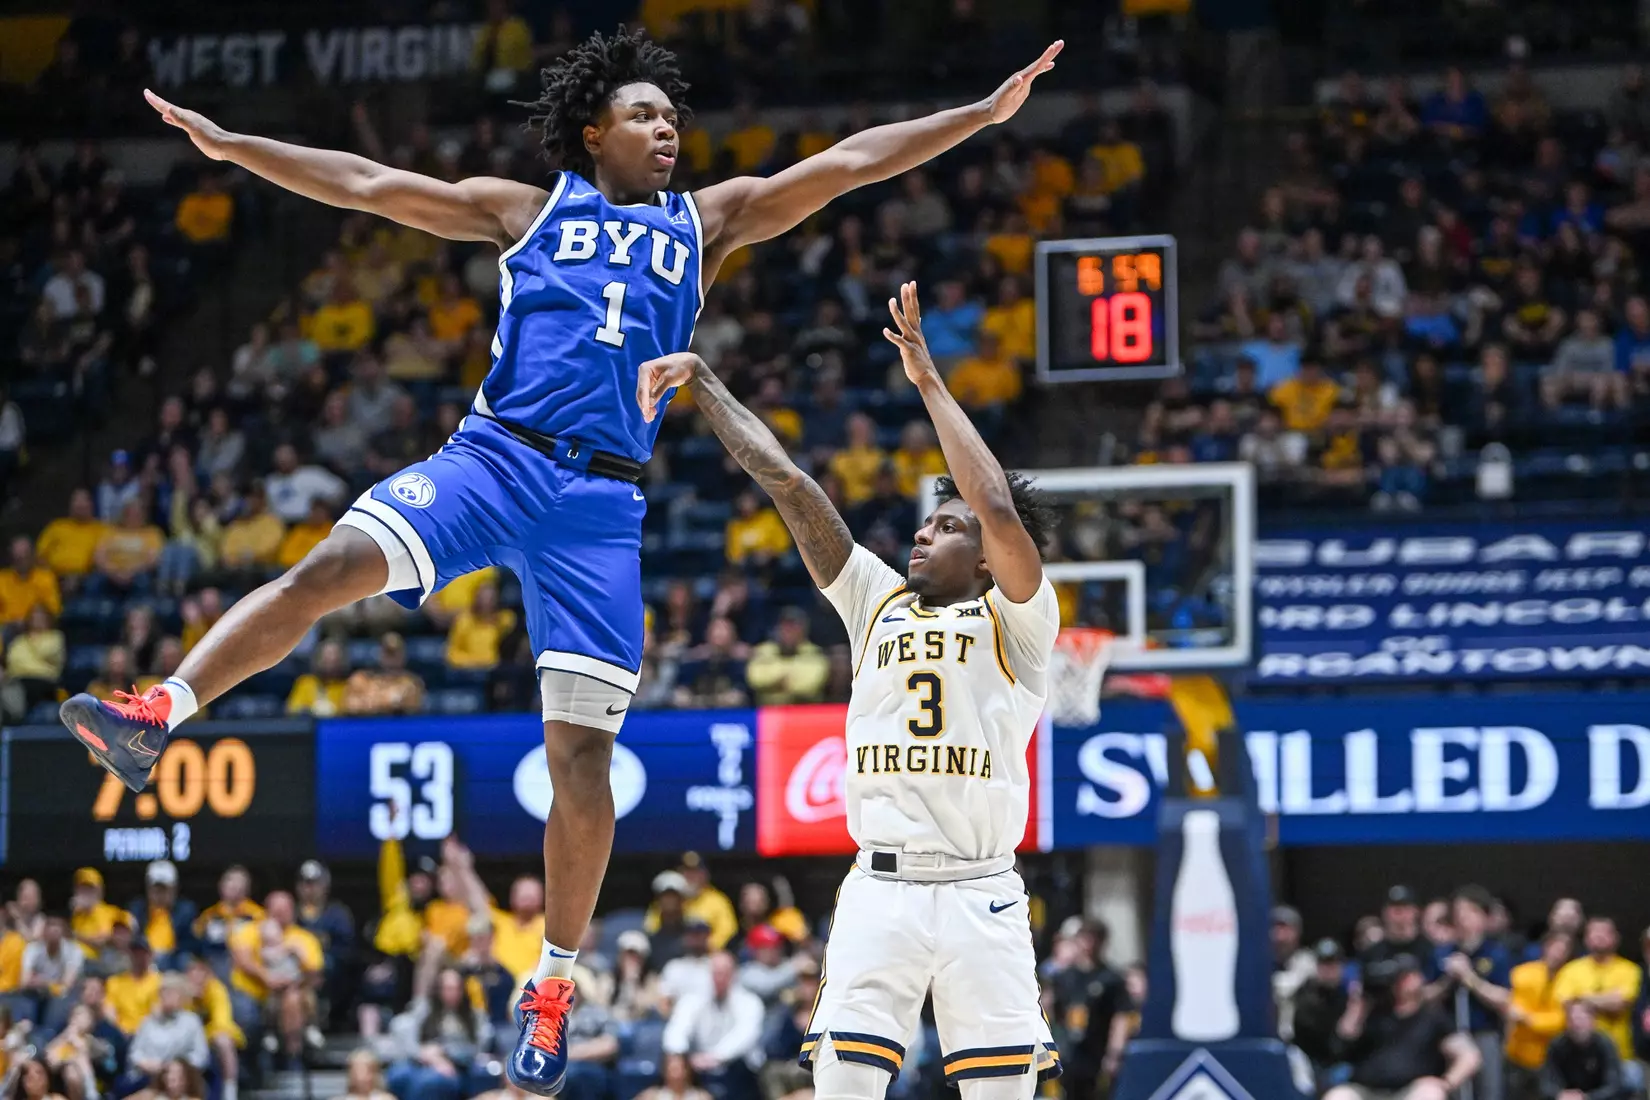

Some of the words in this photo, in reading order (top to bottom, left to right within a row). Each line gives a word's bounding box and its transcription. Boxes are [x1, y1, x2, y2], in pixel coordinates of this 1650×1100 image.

[148, 32, 287, 86] WEST
[553, 220, 690, 286] BYU
[594, 281, 628, 348] 1
[1091, 292, 1153, 363] 18
[877, 630, 977, 670] WEST
[906, 669, 946, 741] 3
[369, 741, 454, 840] 53
[856, 744, 992, 780] VIRGINIA
